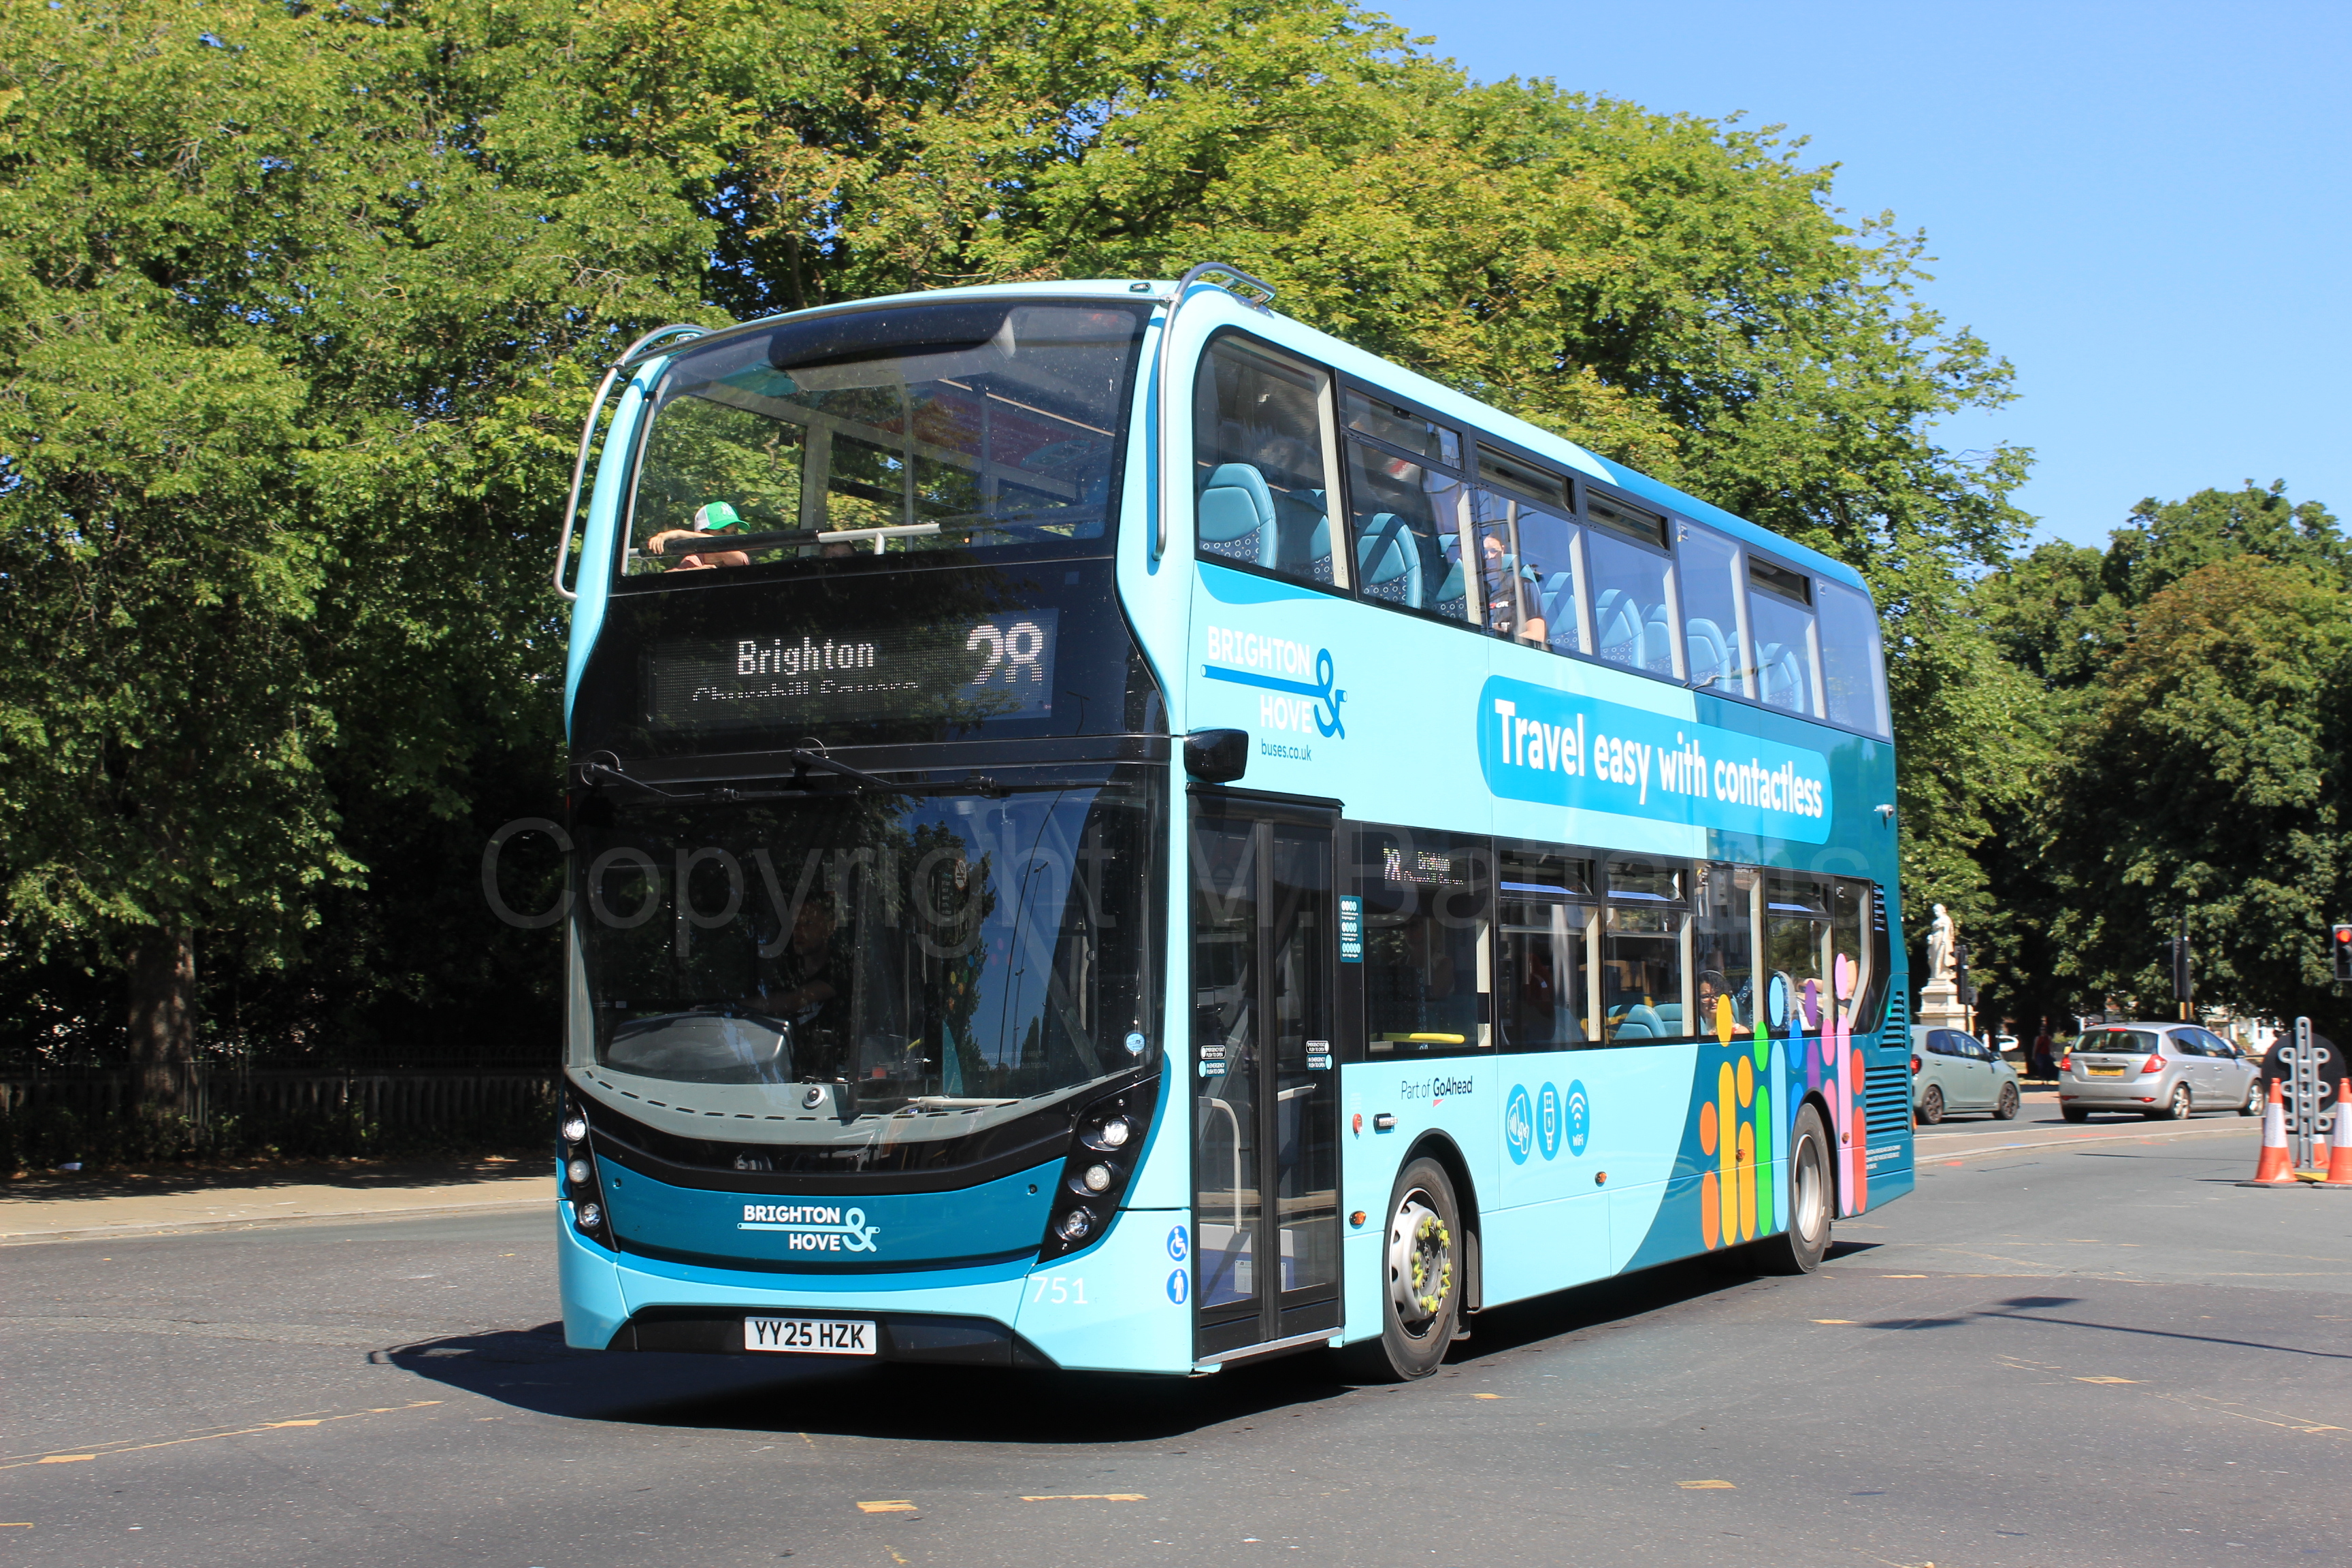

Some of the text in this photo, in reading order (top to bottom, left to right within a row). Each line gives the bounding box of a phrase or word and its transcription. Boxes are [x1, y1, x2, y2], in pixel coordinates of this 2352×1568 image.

[738, 637, 874, 675] Brighton
[966, 622, 1043, 685] 28
[1208, 625, 1310, 676] BRIGHTON
[1260, 695, 1312, 733] HOVE
[1261, 738, 1312, 762] buses.co.uk
[1494, 698, 1823, 818] Travel easy with contactless
[1401, 1075, 1473, 1100] Part of GoAhead
[1572, 1133, 1584, 1146] WiFi
[744, 1205, 840, 1224] BRIGHTON
[789, 1233, 841, 1251] HOVE
[1031, 1277, 1088, 1304] 751
[755, 1321, 864, 1348] YY25 HZK
